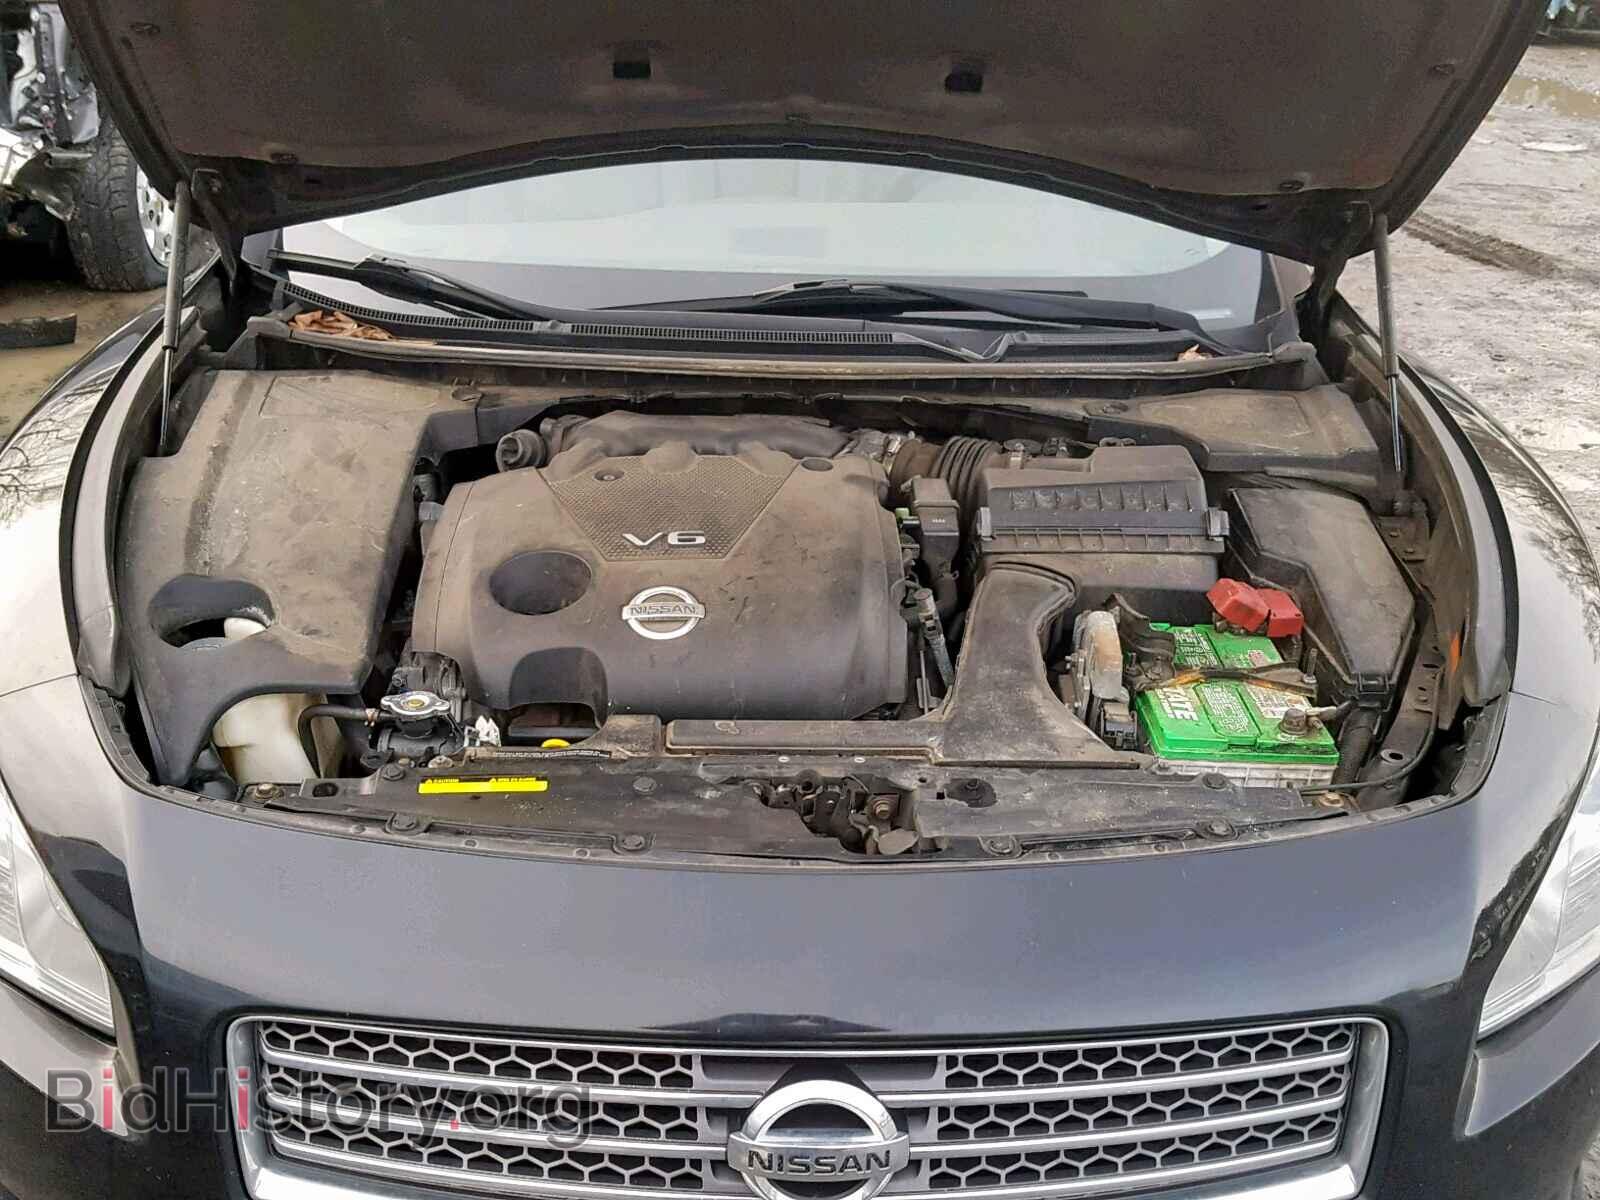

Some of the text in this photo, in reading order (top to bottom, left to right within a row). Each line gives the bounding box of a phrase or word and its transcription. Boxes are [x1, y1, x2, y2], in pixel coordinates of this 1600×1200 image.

[622, 531, 706, 546] V6
[630, 604, 696, 616] NISSAN
[748, 1150, 891, 1173] NISSAN
